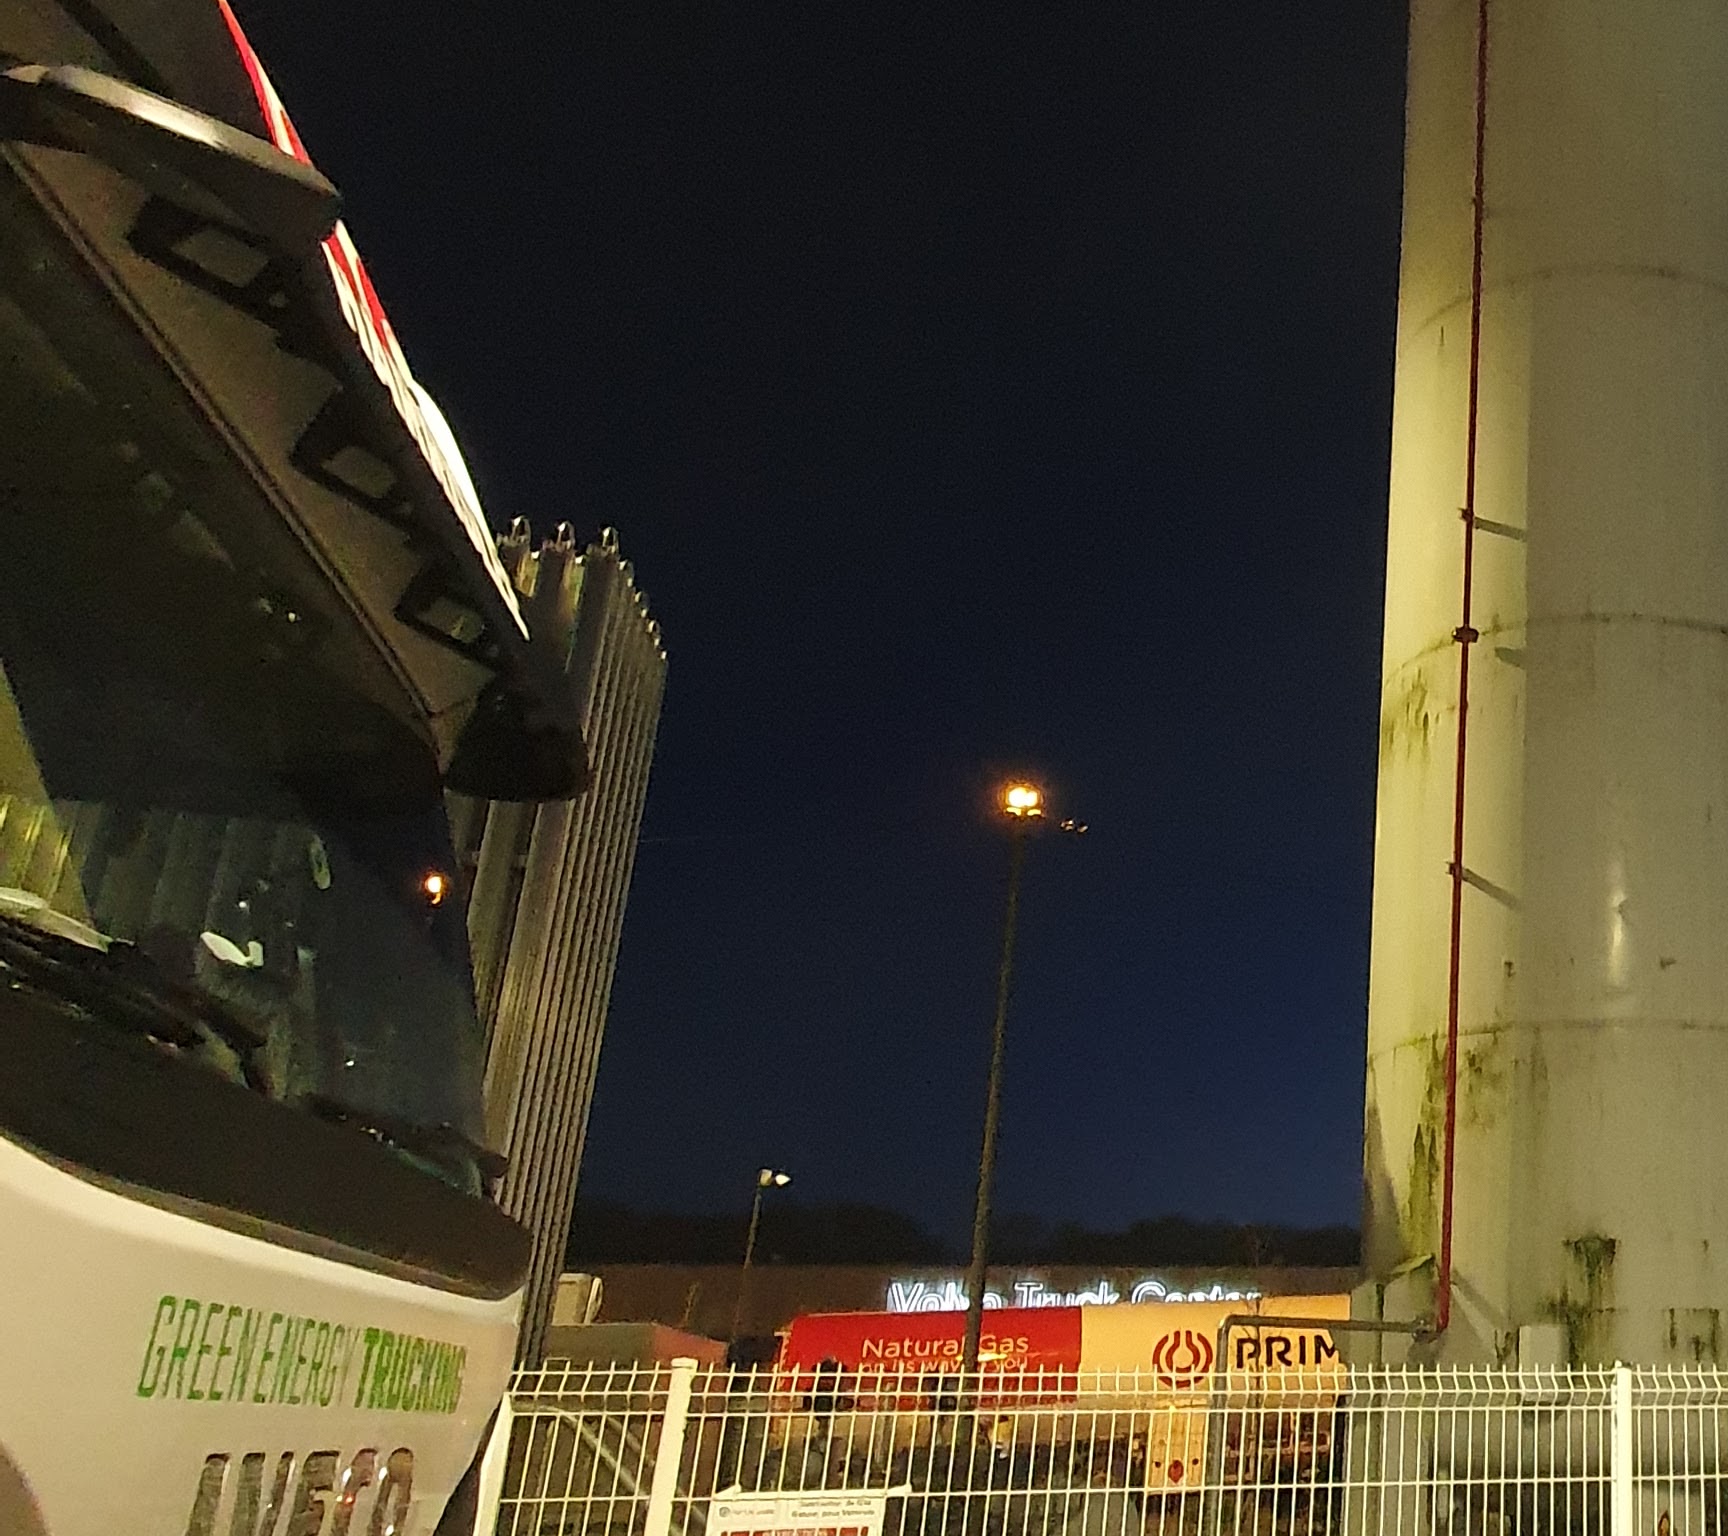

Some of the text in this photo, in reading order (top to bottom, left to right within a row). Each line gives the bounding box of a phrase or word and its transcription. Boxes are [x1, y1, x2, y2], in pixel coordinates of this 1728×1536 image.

[136, 1294, 467, 1414] GREEN ENERGY TRUCKING
[861, 1333, 1029, 1359] Natural Gas
